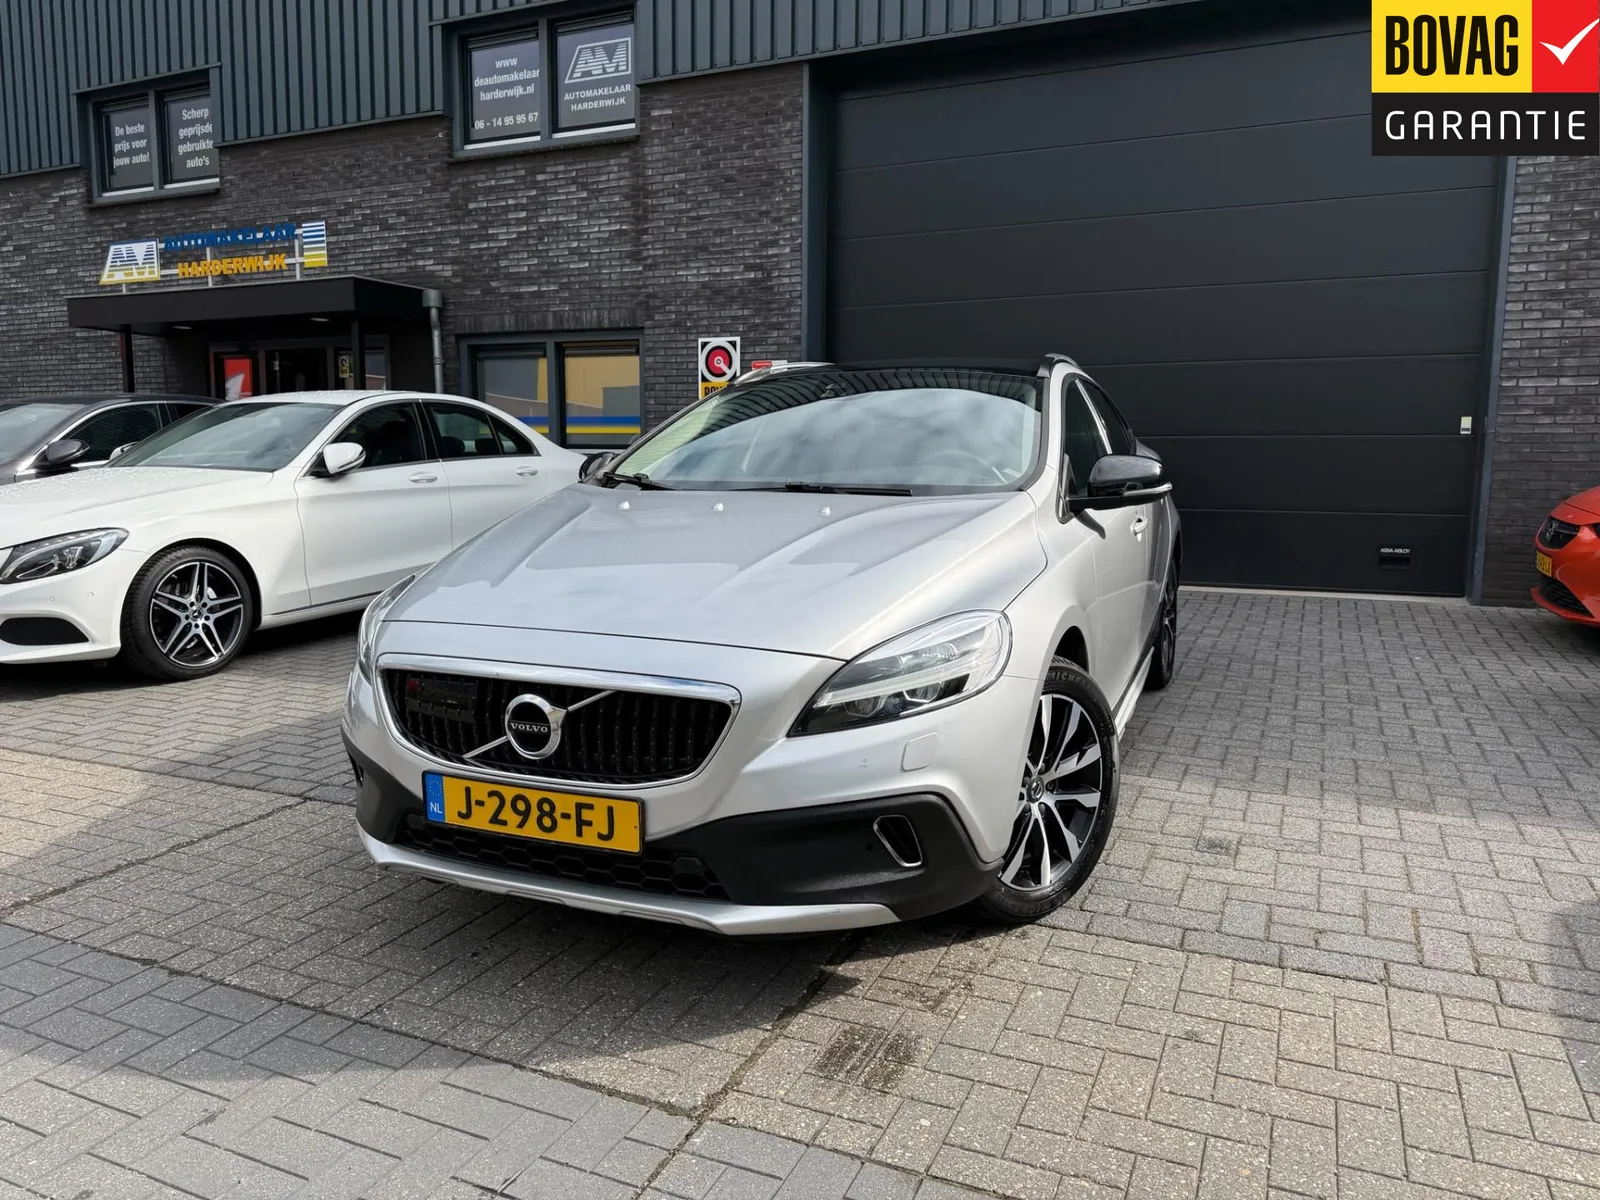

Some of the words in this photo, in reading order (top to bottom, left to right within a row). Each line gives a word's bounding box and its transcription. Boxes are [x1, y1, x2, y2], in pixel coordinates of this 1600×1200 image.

[495, 57, 518, 69] www
[572, 42, 627, 79] AM
[474, 68, 540, 87] deautomakelaar
[480, 83, 535, 101] harderwijk.nl
[564, 83, 632, 101] AUTOMAKELAAR
[571, 97, 626, 112] HARDERWIJK
[182, 107, 209, 120] Scherp
[474, 119, 485, 130] 06
[492, 117, 502, 128] 14
[503, 115, 515, 126] 95
[516, 113, 527, 125] 95
[528, 112, 539, 123] 67
[115, 126, 125, 136] De
[125, 123, 145, 135] beste
[114, 141, 131, 153] prijs
[131, 139, 148, 149] voor
[178, 139, 213, 155] gebruikte
[113, 156, 130, 169] jouw
[131, 152, 150, 164] auto!
[186, 155, 210, 168] auto's
[177, 254, 288, 278] HARDERWIJK
[510, 721, 549, 733] VOLVO
[430, 802, 443, 814] NL
[456, 785, 616, 842] J-298-FJ
